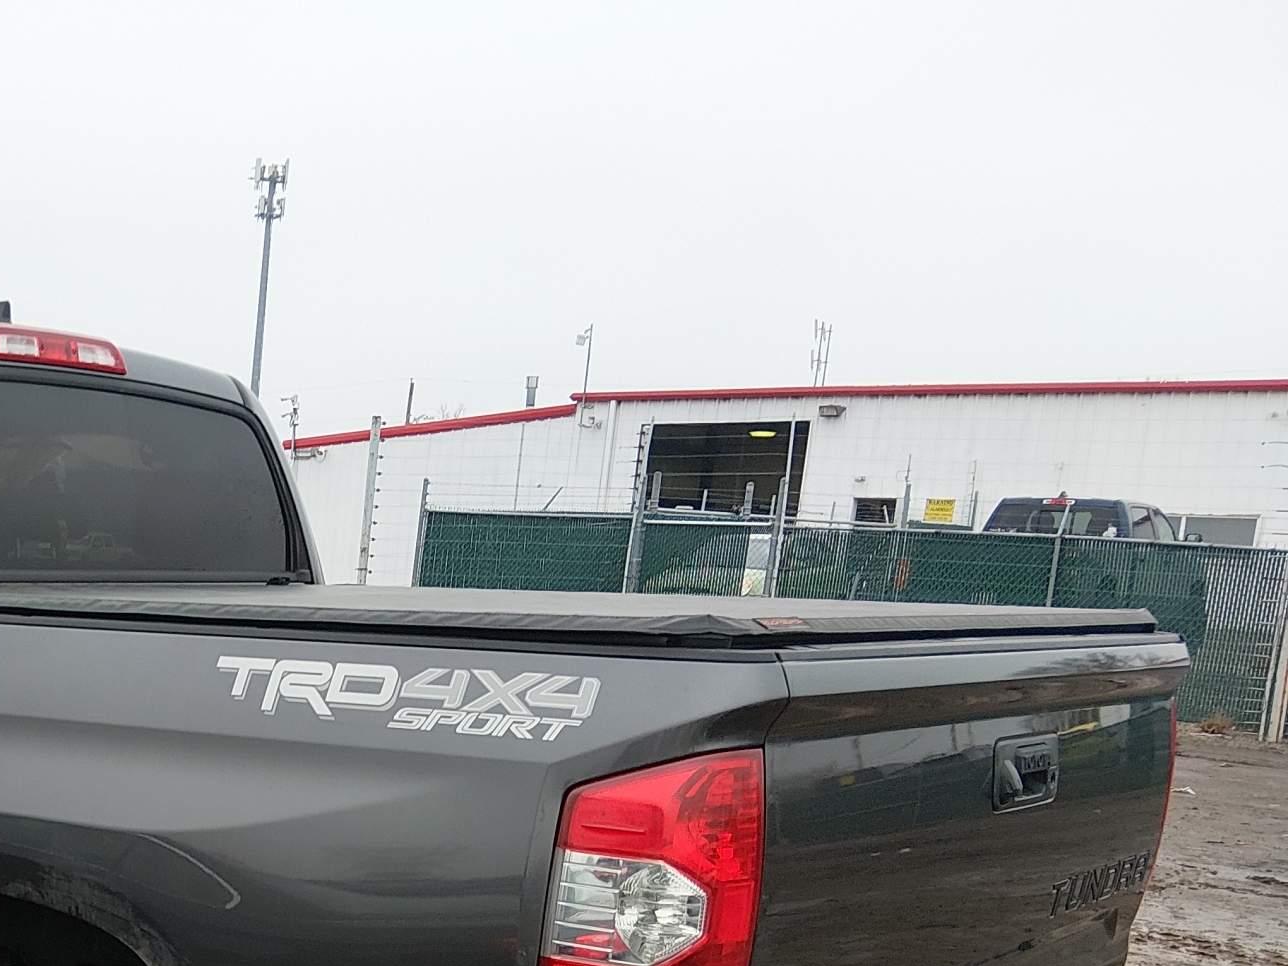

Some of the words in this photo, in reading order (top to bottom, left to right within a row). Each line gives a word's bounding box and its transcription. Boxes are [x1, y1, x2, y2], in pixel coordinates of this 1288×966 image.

[216, 656, 401, 720] TRD
[386, 708, 584, 741] SPORT
[1049, 850, 1151, 919] TUNDRA
